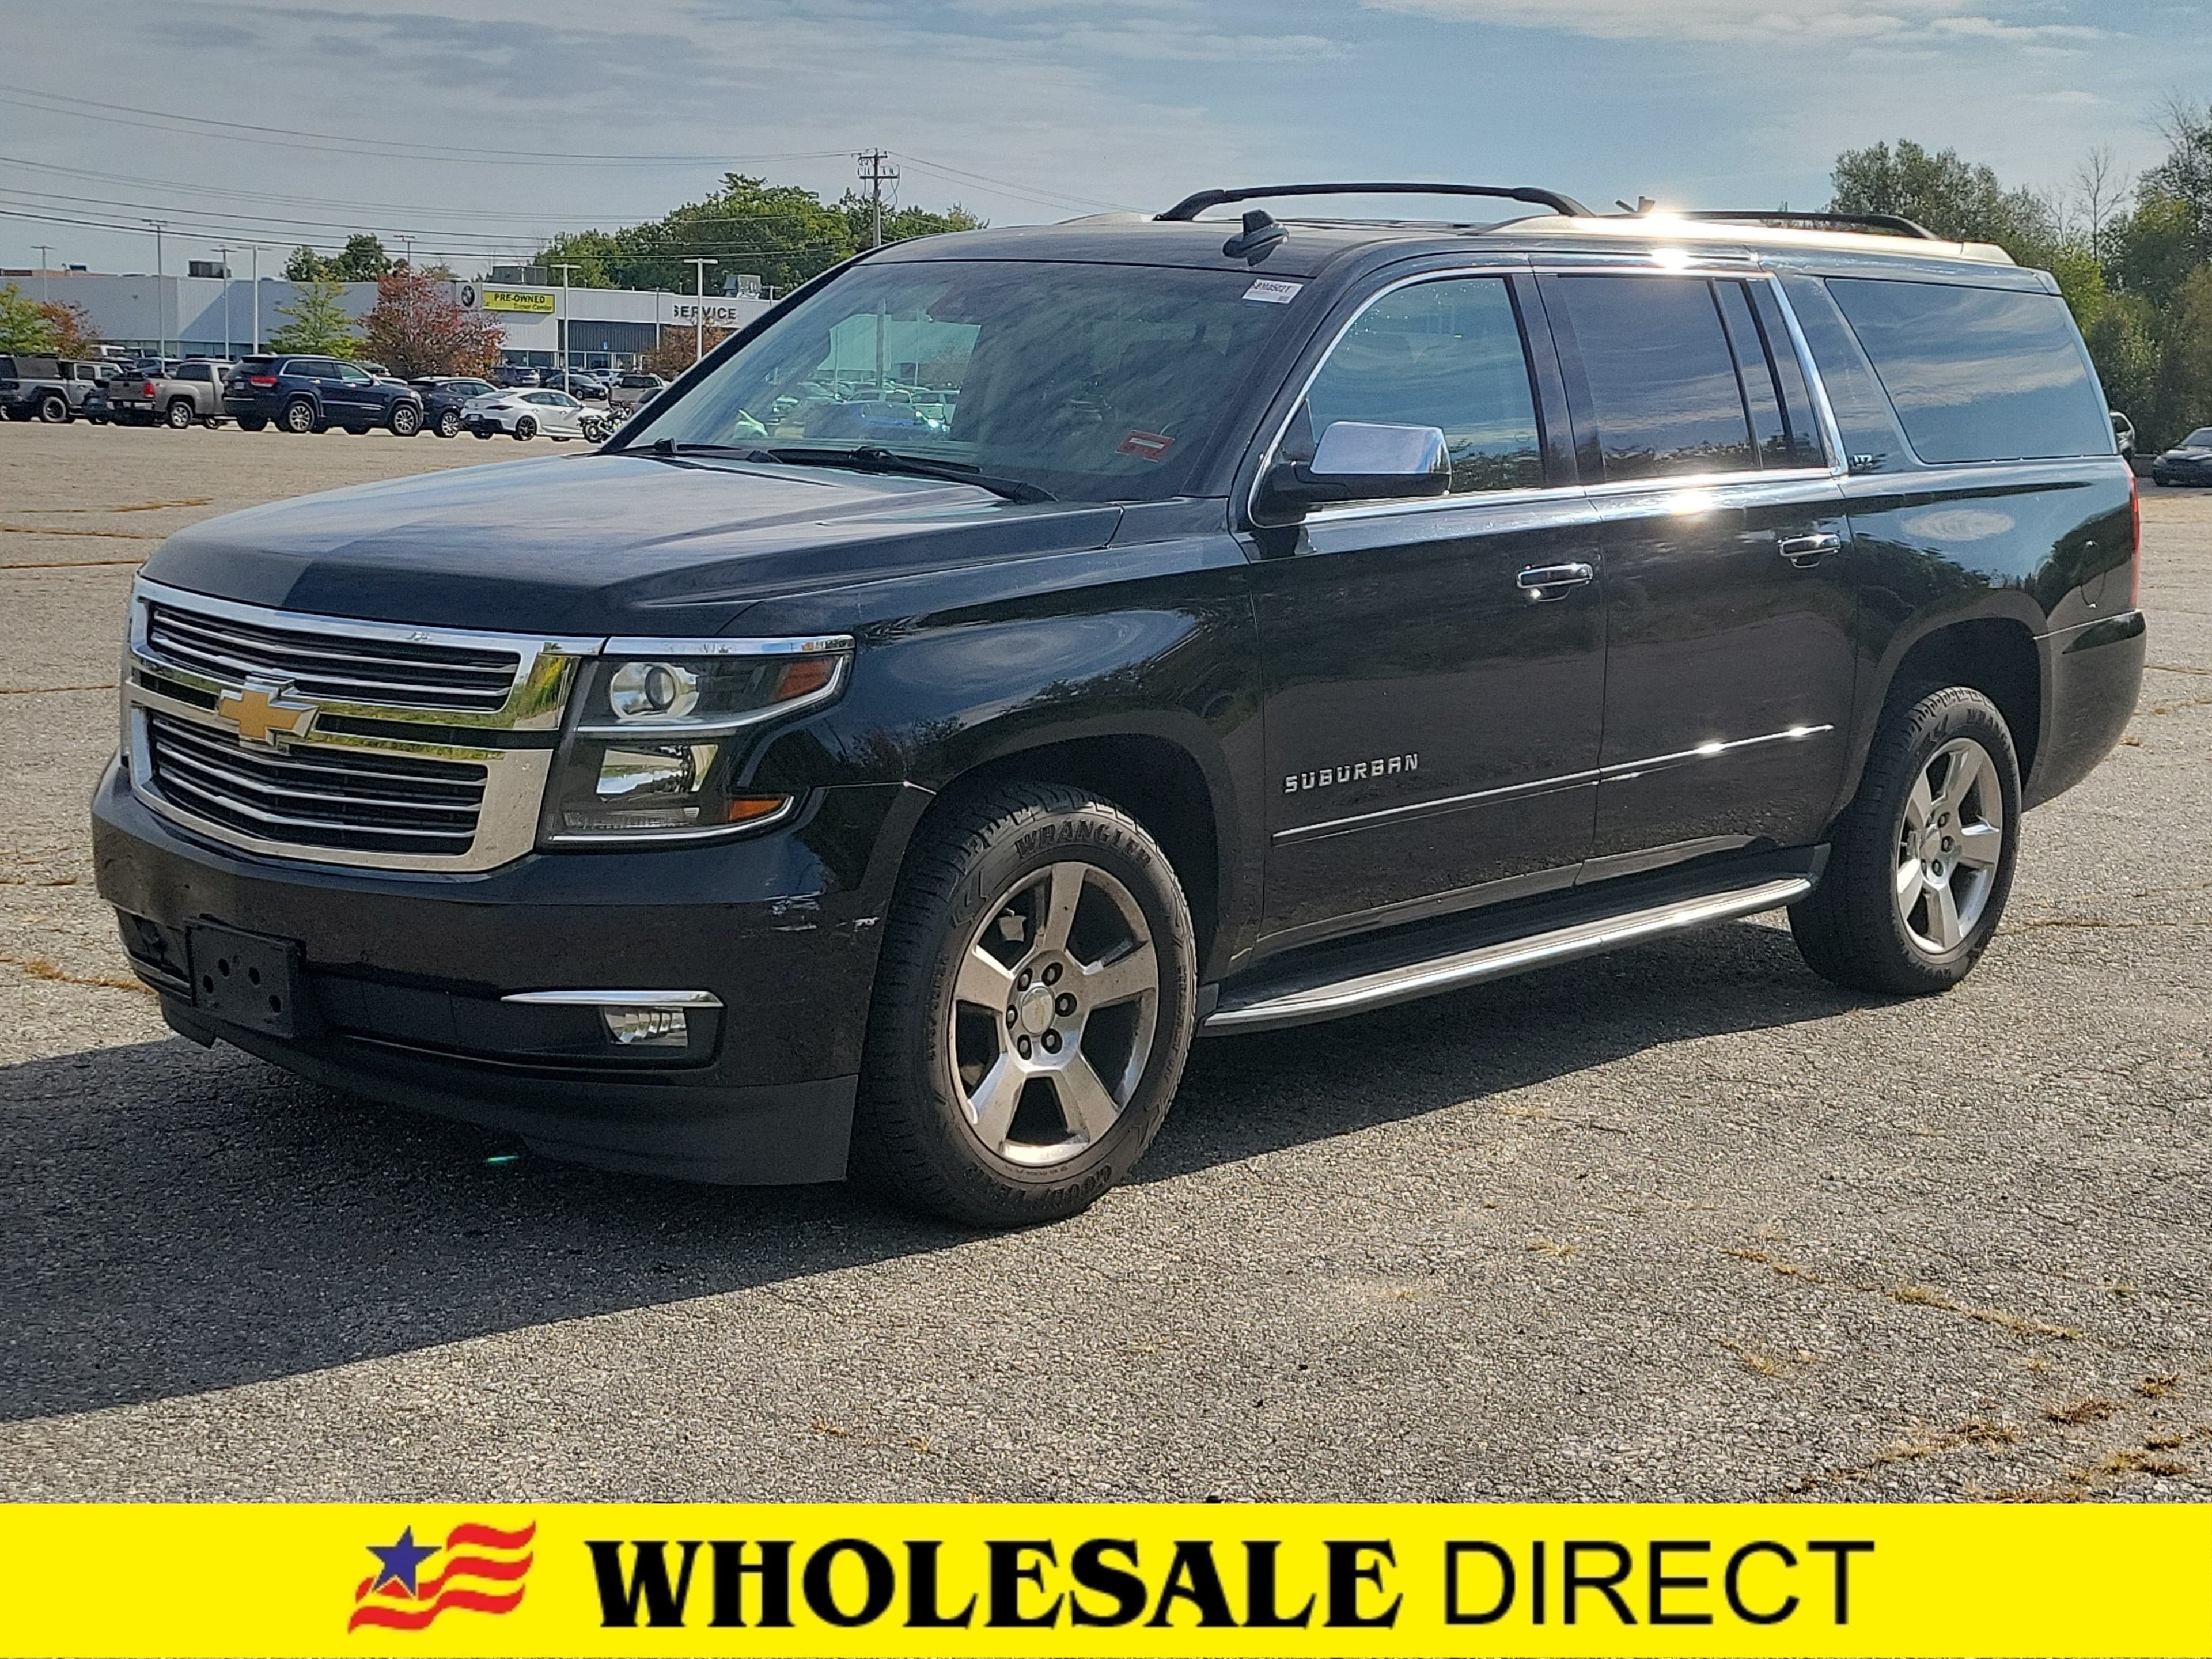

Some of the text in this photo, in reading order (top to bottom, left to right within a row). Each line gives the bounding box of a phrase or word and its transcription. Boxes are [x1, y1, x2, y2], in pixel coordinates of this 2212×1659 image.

[494, 293, 546, 304] PRE-OWNED
[673, 305, 737, 319] SERVICE
[1284, 753, 1418, 794] SUBURBAN
[1013, 818, 1152, 864] WRANGLER
